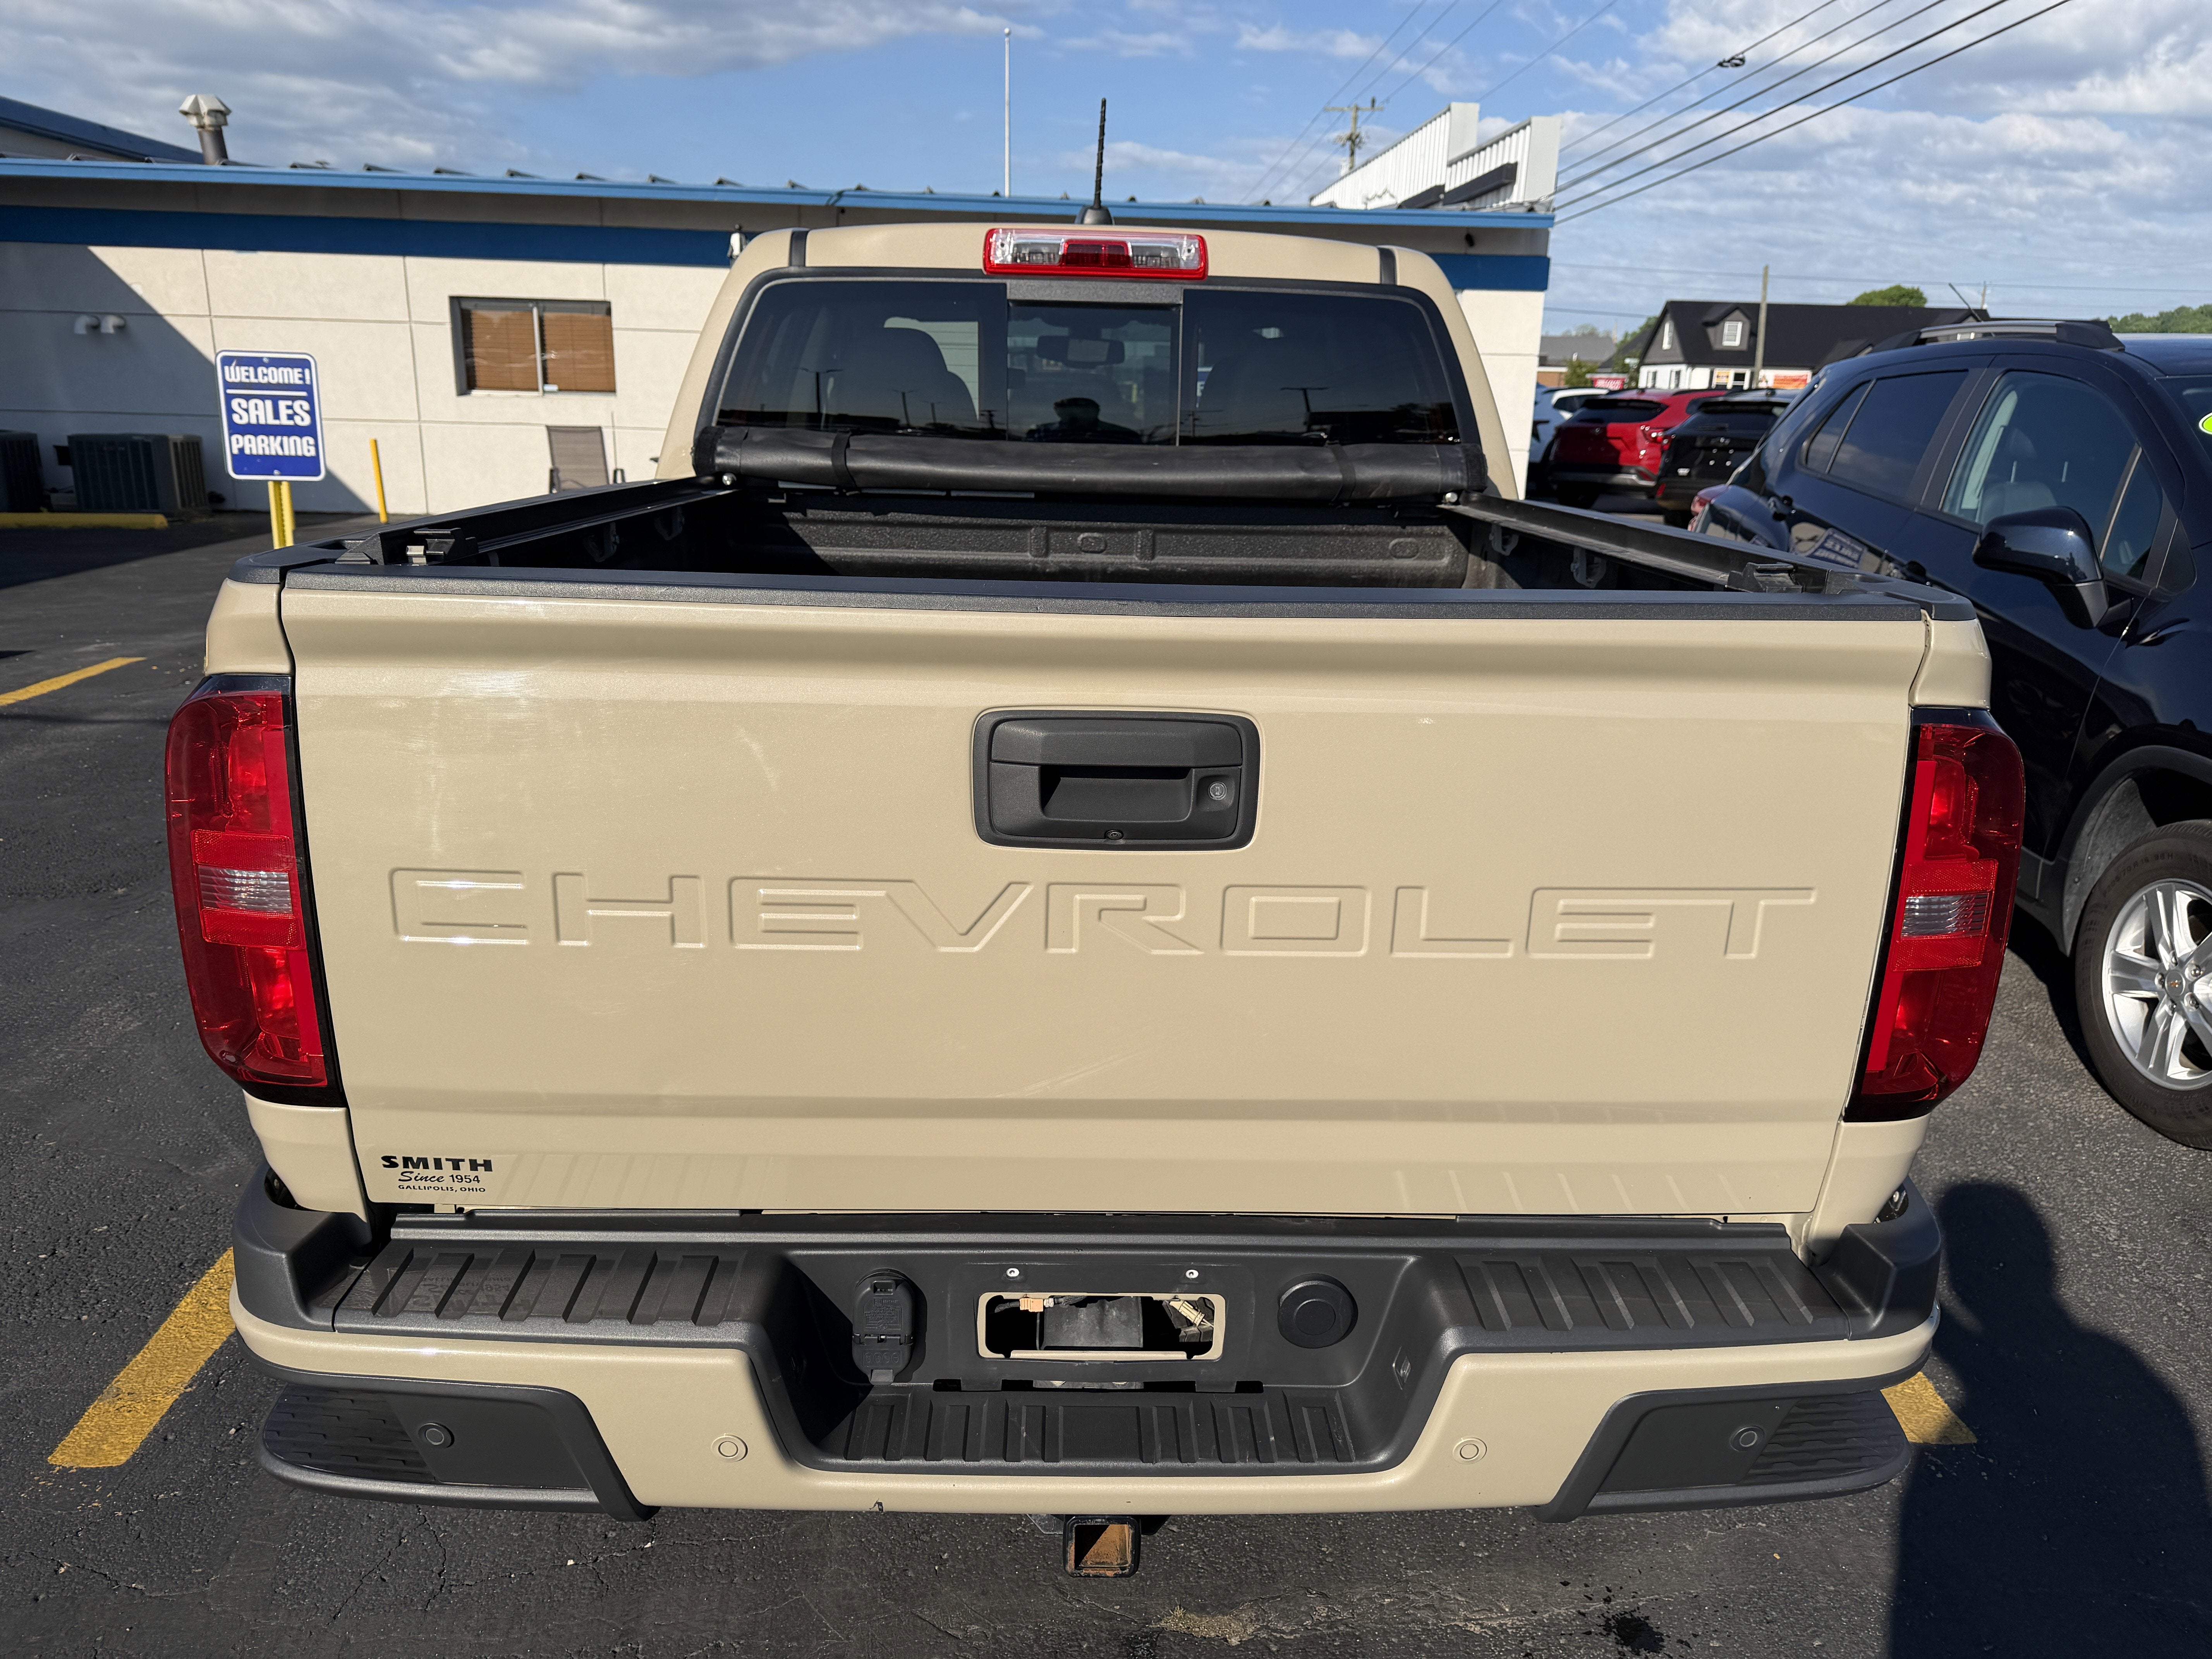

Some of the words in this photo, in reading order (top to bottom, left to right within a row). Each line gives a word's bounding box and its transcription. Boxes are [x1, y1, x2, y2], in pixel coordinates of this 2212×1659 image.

[223, 365, 311, 385] WELCOME!
[231, 398, 311, 426] SALES
[230, 434, 316, 457] PARKING
[390, 868, 1817, 959] CHEVROLET
[381, 1155, 493, 1172] SMITH
[398, 1171, 445, 1182] Since
[449, 1175, 480, 1183] 1954
